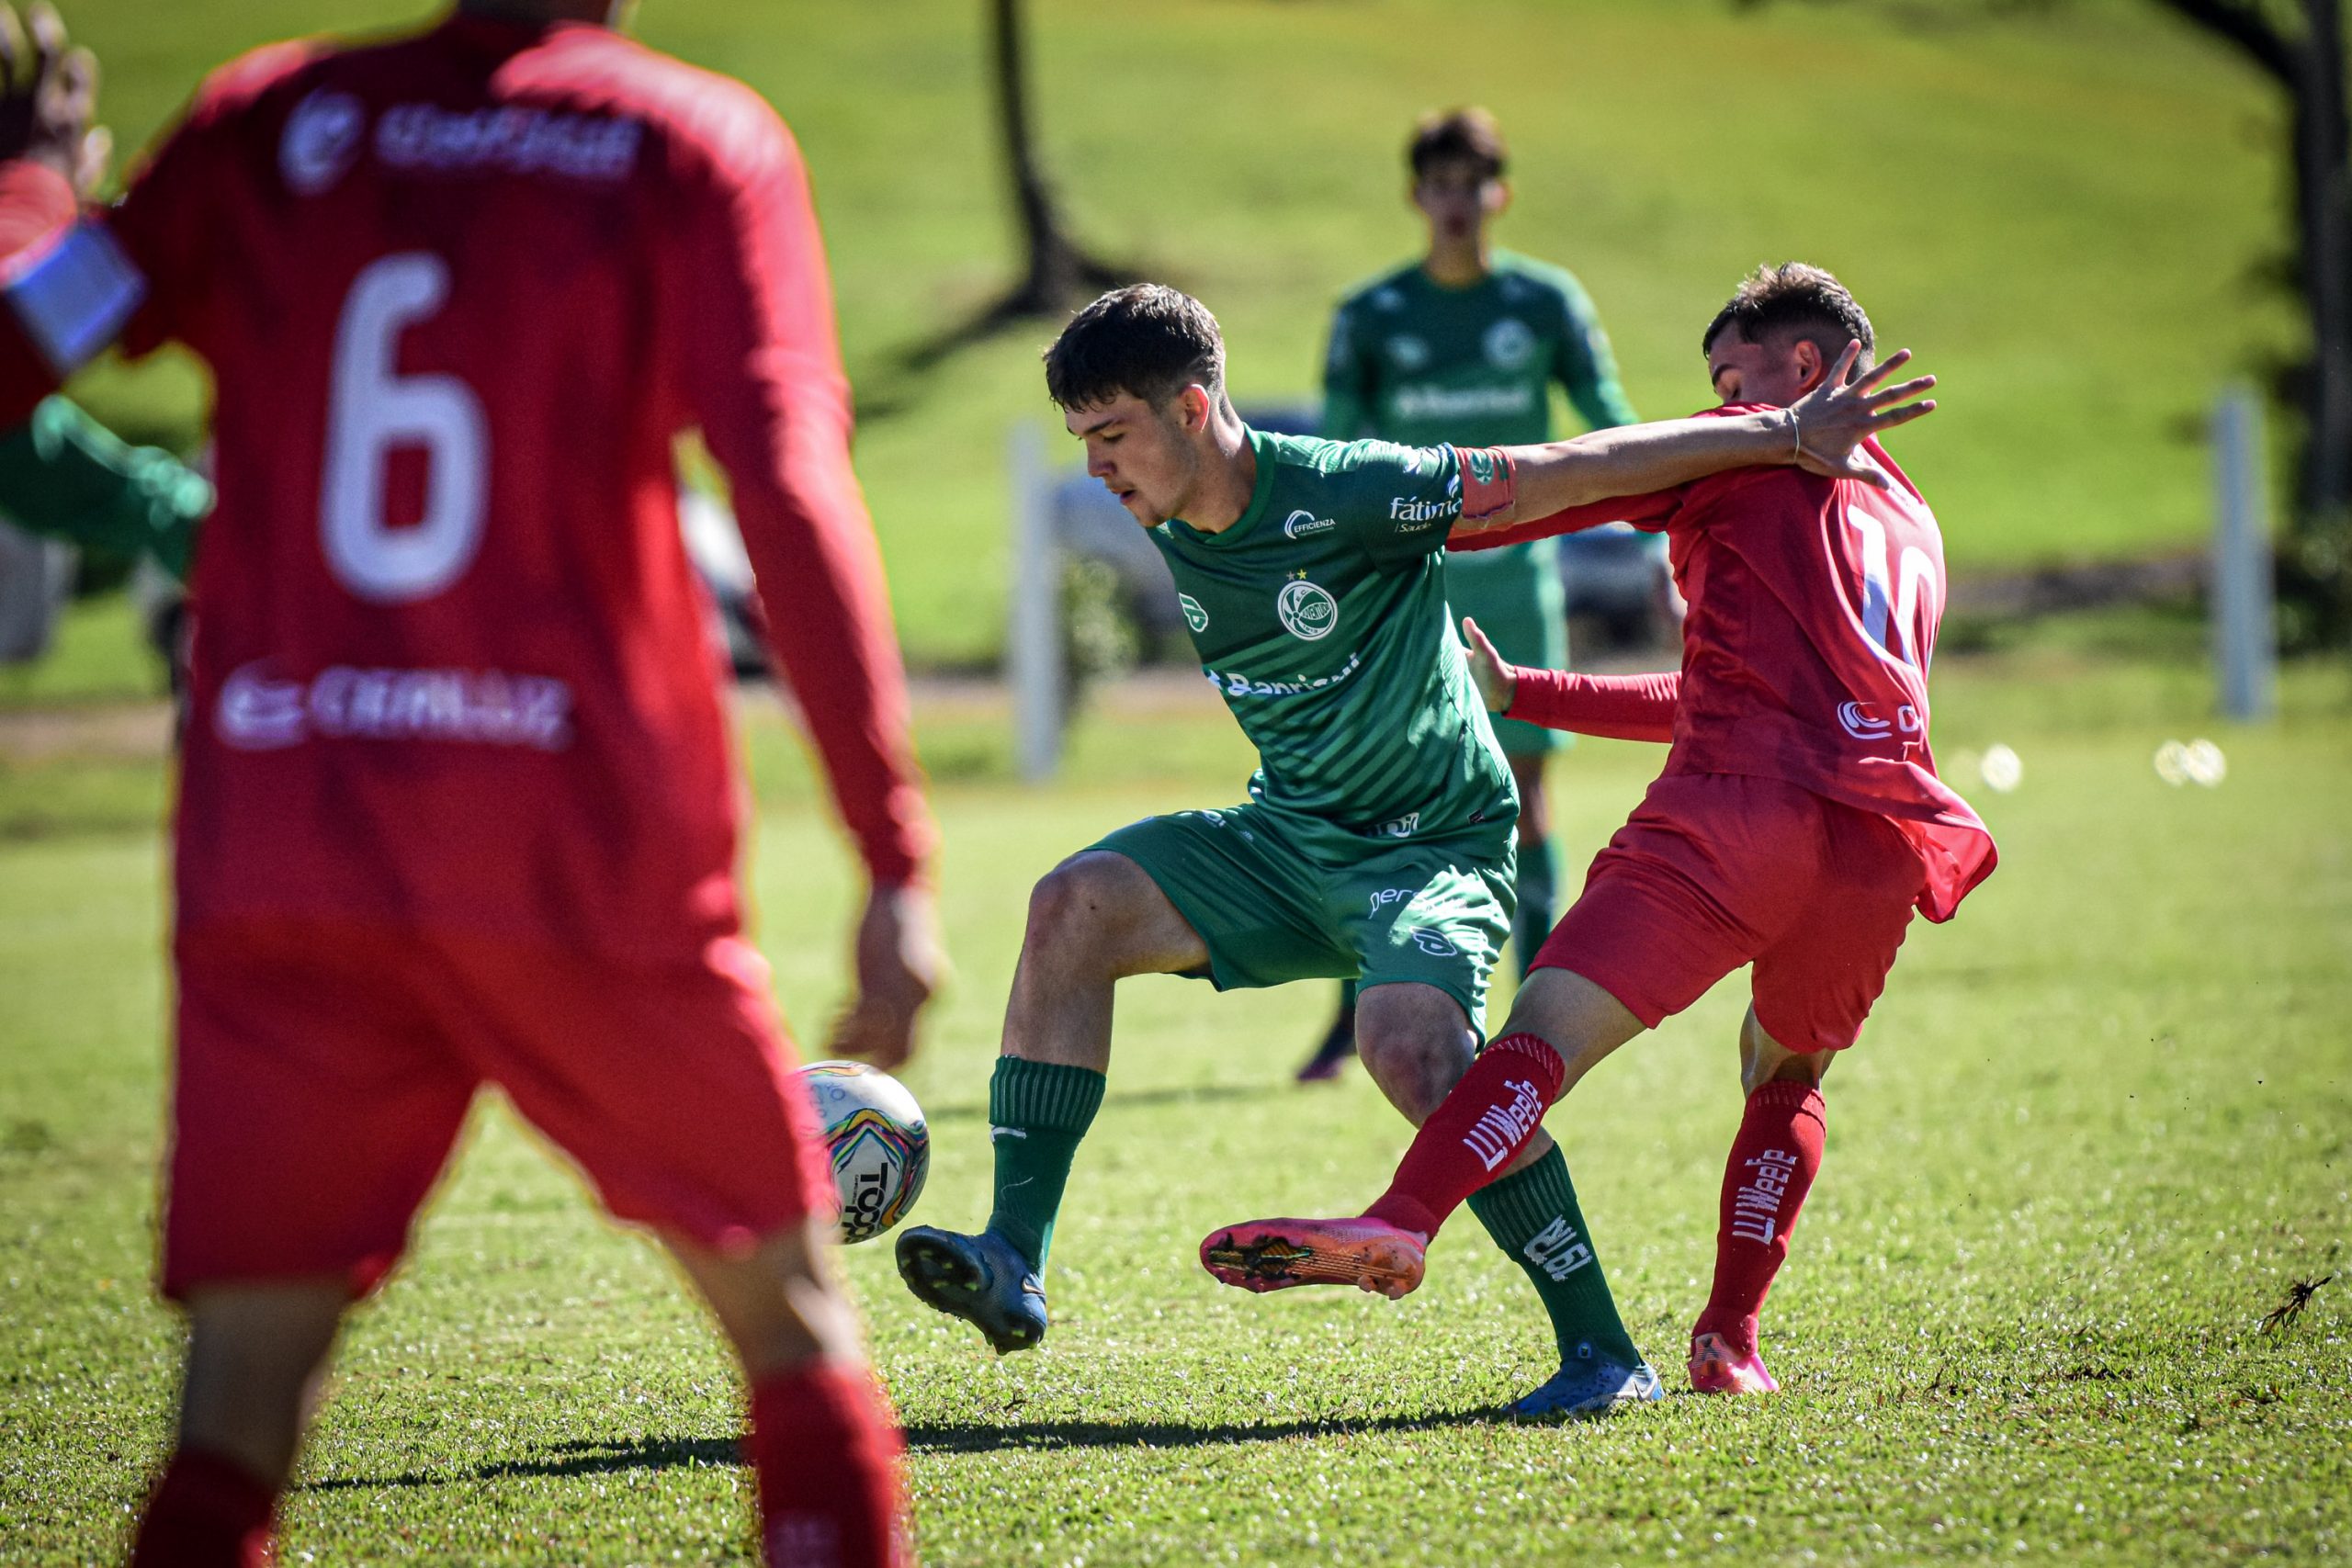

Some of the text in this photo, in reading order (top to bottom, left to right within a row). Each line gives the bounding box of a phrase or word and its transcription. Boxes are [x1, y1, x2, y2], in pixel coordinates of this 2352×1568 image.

[322, 253, 490, 601] 6
[1294, 518, 1336, 533] EFFICIENZA
[1847, 504, 1937, 669] 10
